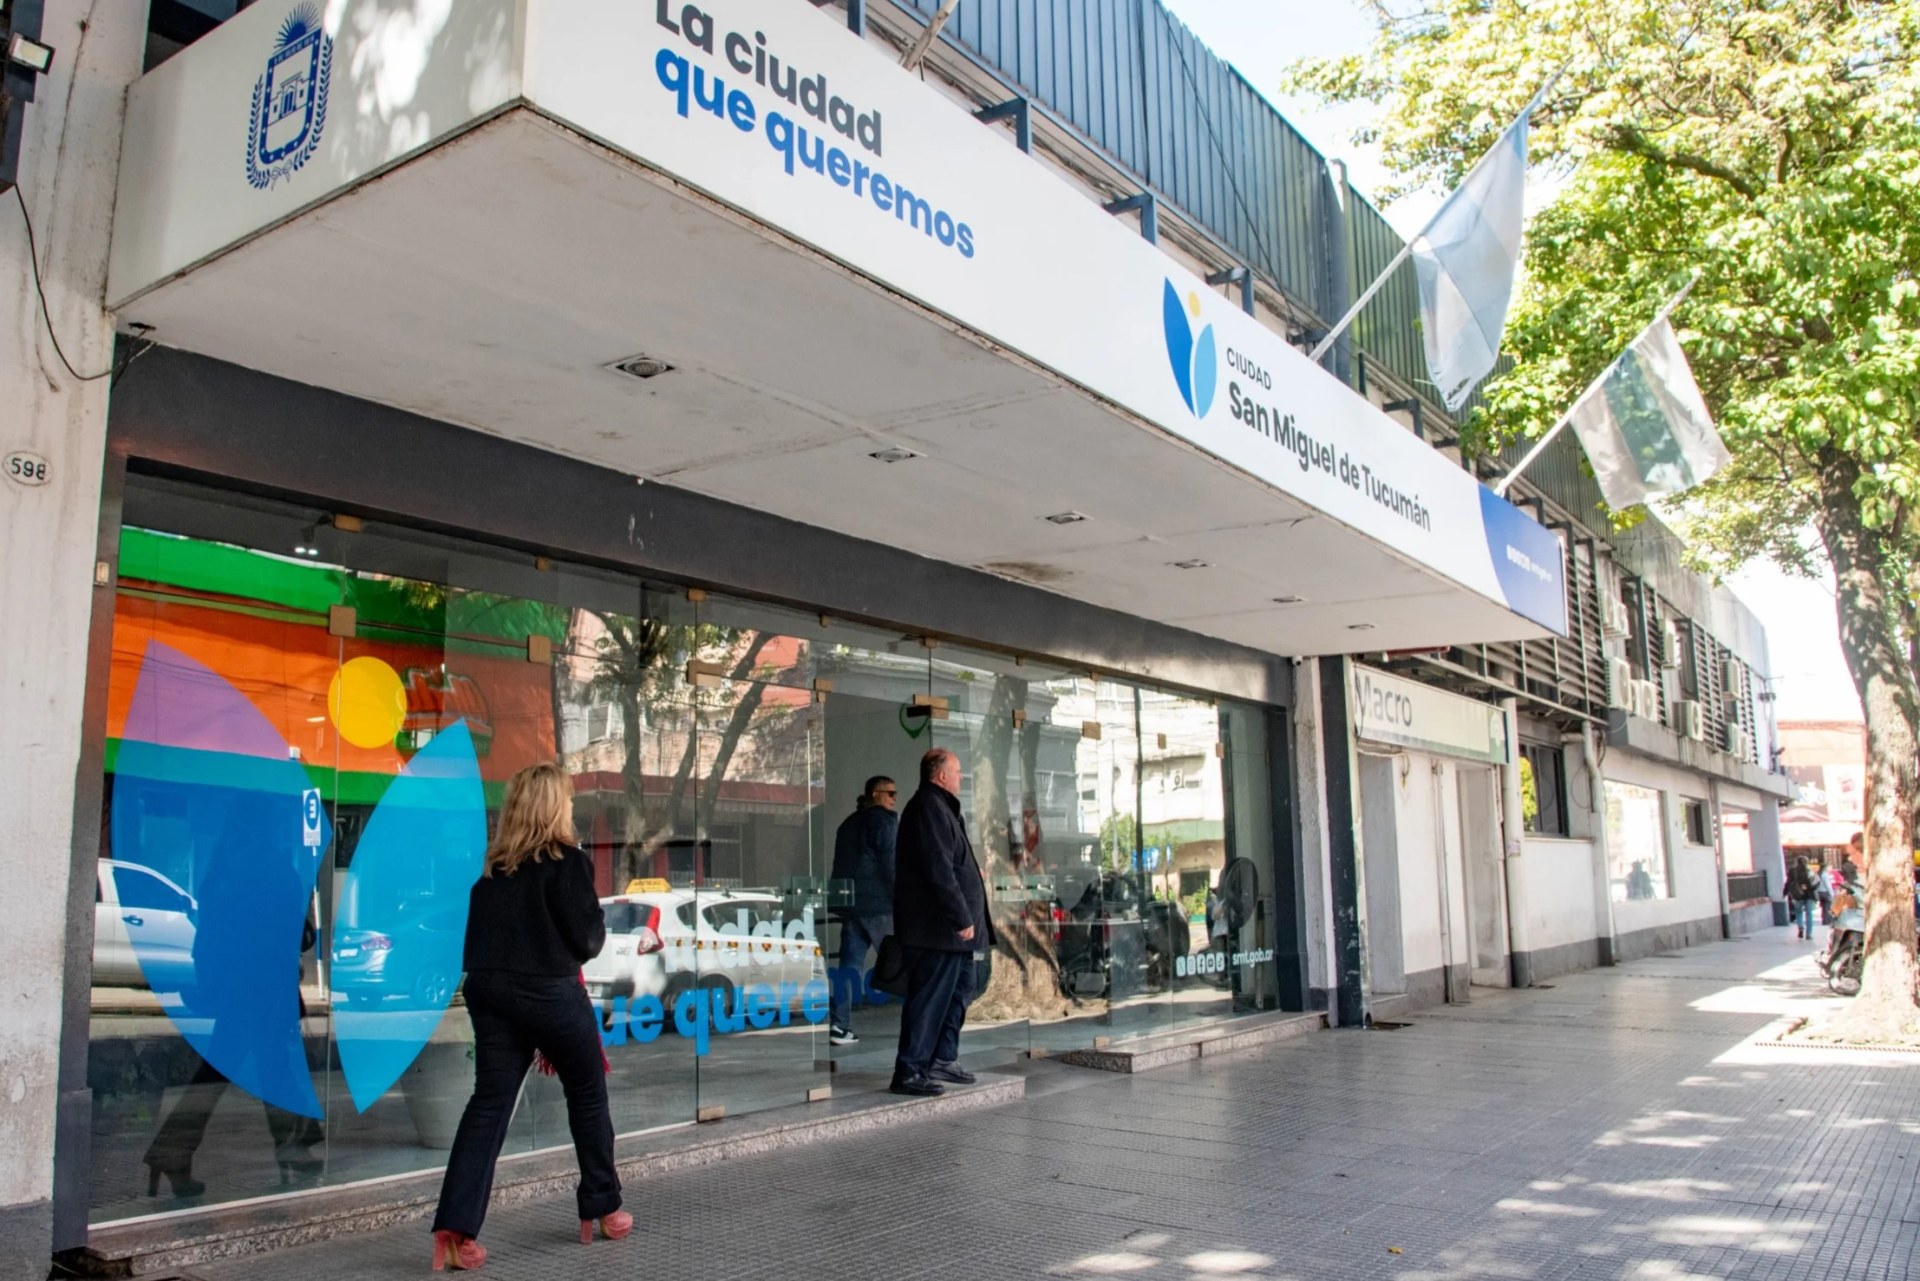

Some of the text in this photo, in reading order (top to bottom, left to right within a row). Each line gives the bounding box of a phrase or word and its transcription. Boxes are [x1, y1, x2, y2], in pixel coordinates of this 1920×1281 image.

[656, 0, 882, 157] La ciudad
[655, 48, 974, 259] que queremos
[1227, 347, 1272, 390] CIUDAD
[11, 457, 46, 480] 598
[1229, 381, 1431, 532] San Miguel de Tucumán
[1232, 947, 1274, 968] smt.gob.ar
[594, 992, 664, 1048] ue
